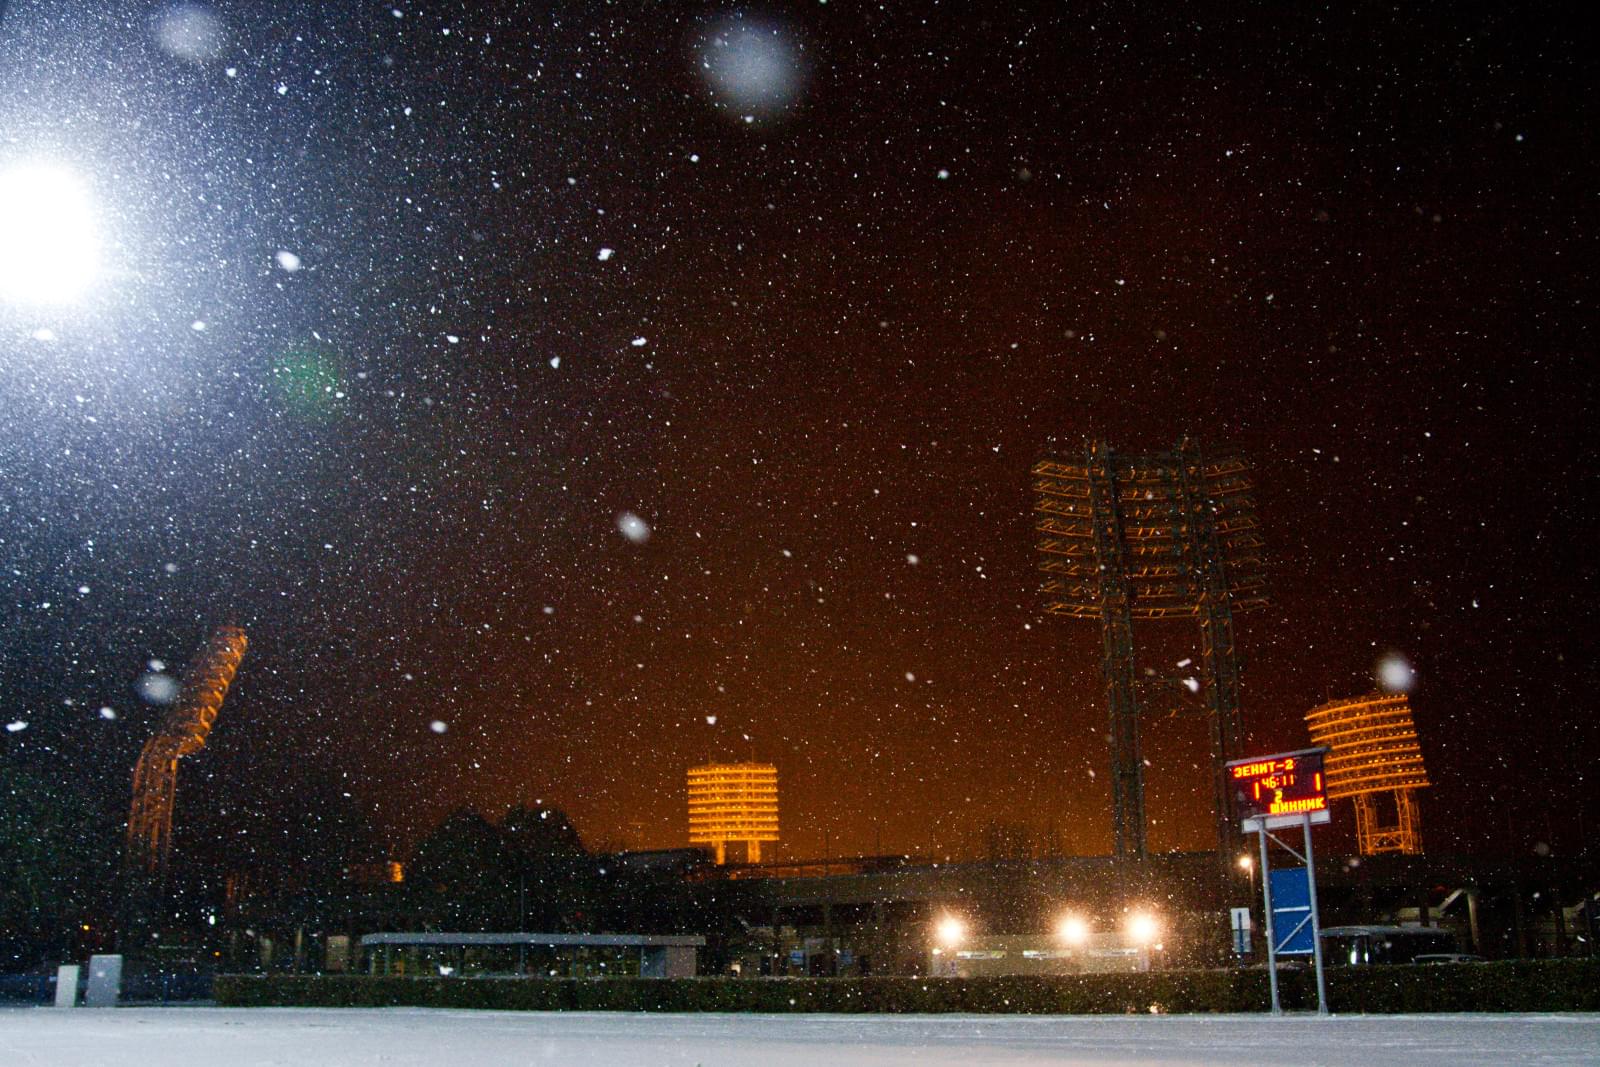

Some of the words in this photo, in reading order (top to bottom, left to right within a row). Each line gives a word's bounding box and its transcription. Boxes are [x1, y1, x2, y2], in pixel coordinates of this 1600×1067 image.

[1234, 759, 1294, 778] ЗЕНИТ-2
[1275, 790, 1283, 803] 2
[1270, 797, 1325, 814] ШИННИК
